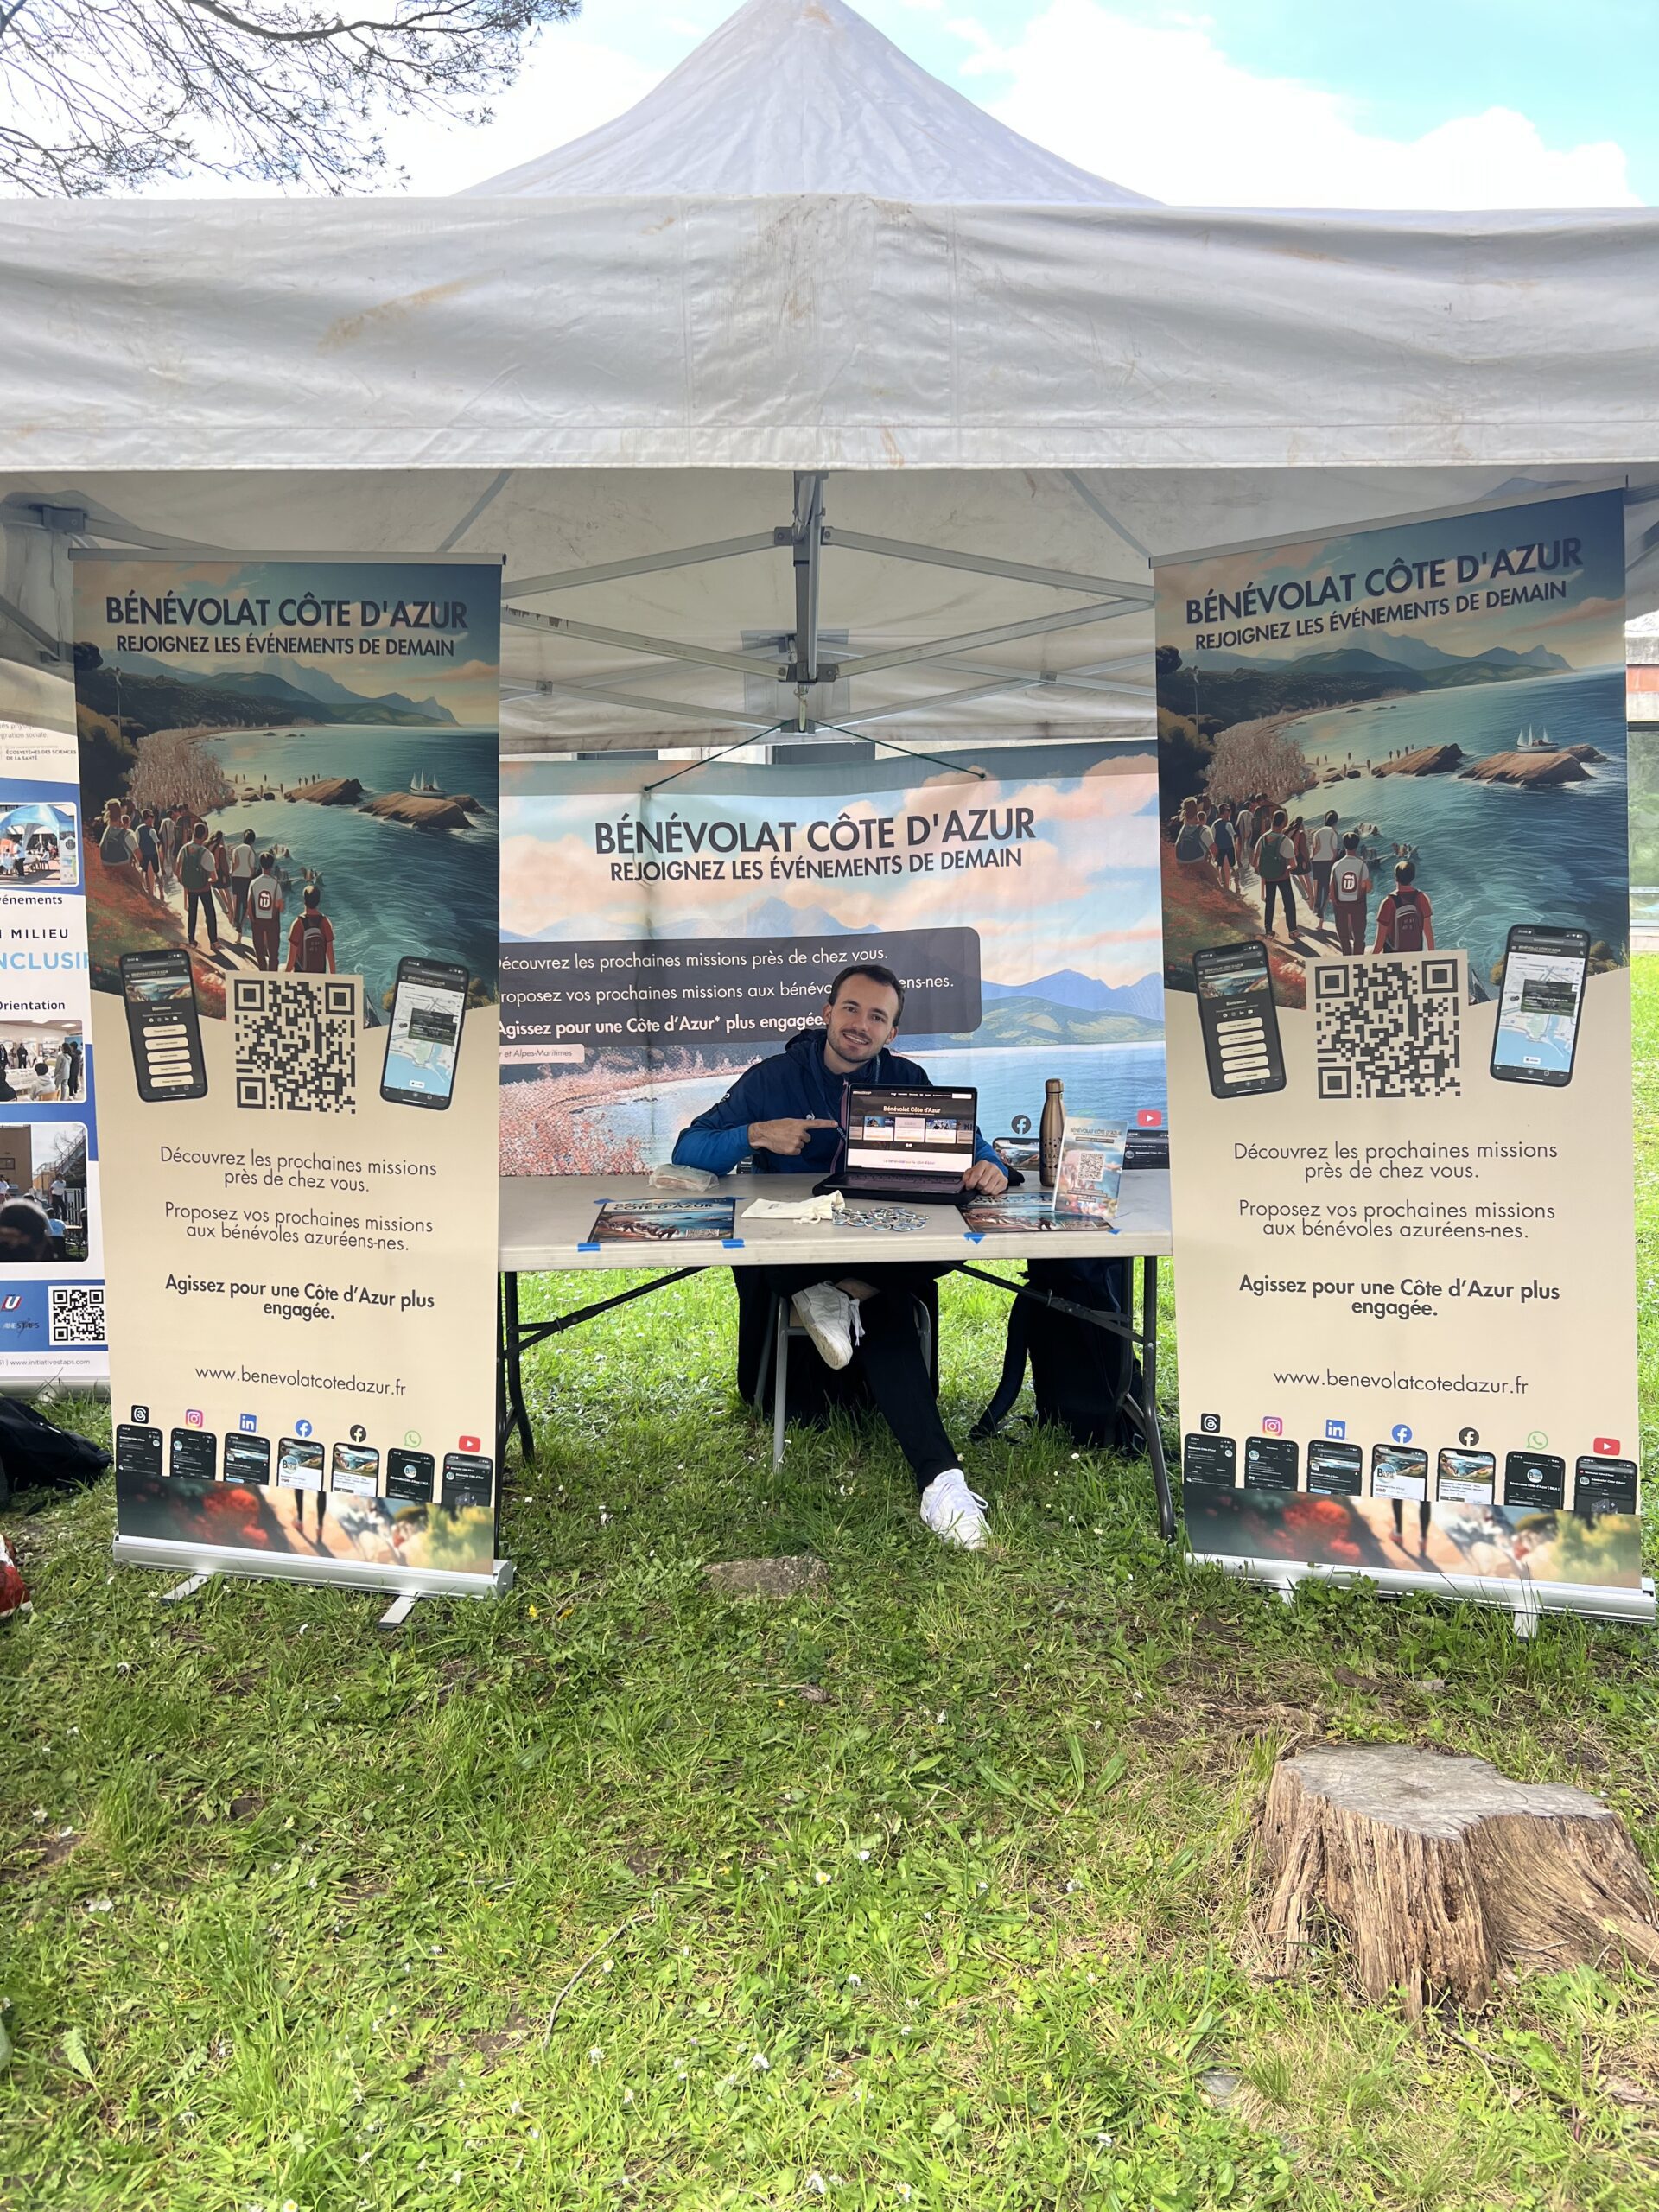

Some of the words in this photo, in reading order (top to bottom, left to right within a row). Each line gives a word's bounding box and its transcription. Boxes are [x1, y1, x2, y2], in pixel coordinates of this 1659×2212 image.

[1186, 573, 1356, 624] BÉNÉVOLAT
[1365, 556, 1446, 596] CÔTE
[1457, 537, 1583, 584] D'AZUR
[105, 589, 270, 626] BÉNÉVOLAT
[278, 591, 351, 627] CÔTE
[360, 600, 468, 629] D'AZUR
[1195, 621, 1291, 650] REJOIGNEZ
[1296, 617, 1324, 636] LES
[1330, 598, 1450, 632] ÉVÉNEMENTS
[1456, 593, 1479, 613] DE
[1486, 580, 1567, 609] DEMAIN
[117, 635, 210, 652] REJOIGNEZ
[214, 636, 241, 654] LES
[246, 632, 354, 654] ÉVÉNEMENTS
[359, 638, 380, 655] DE
[386, 639, 454, 657] DEMAIN
[595, 812, 796, 854] BÉNÉVOLAT
[807, 812, 895, 852] CÔTE
[906, 807, 1036, 846] D'AZUR
[610, 861, 725, 881] REJOIGNEZ
[732, 861, 763, 880] LES
[770, 855, 902, 880] ÉVÉNEMENTS
[909, 852, 934, 873] DE
[941, 848, 1022, 870] DEMAIN
[0, 894, 63, 905] énements
[11, 929, 68, 938] MILIEU
[499, 956, 570, 970] écouvrez
[575, 952, 594, 969] les
[600, 951, 681, 972] prochaines
[686, 952, 747, 967] missions
[752, 950, 784, 969] près
[788, 948, 807, 964] de
[812, 947, 848, 963] chez
[852, 949, 888, 961] vous.
[0, 1001, 66, 1010] rientation
[501, 991, 562, 1007] roposez
[566, 991, 591, 1001] vos
[596, 984, 677, 1005] prochaines
[683, 985, 743, 999] missions
[747, 987, 776, 997] aux
[780, 981, 832, 996] bénévo
[556, 1022, 591, 1039] pour
[595, 1021, 622, 1033] une
[626, 1017, 660, 1033] Côte
[726, 1014, 755, 1033] plus
[760, 1012, 828, 1031] engagée.
[513, 1048, 573, 1059] Alpes-Maritimes
[160, 1146, 245, 1166] Découvrez
[251, 1148, 271, 1166] les
[277, 1152, 362, 1173] prochaines
[368, 1159, 437, 1176] missions
[1234, 1142, 1328, 1159] Découvrez
[1335, 1141, 1358, 1159] les
[1366, 1140, 1470, 1164] prochaines
[1477, 1141, 1558, 1158] missions
[224, 1168, 257, 1188] près
[263, 1168, 283, 1185] de
[289, 1170, 325, 1189] chez
[330, 1179, 369, 1192] vous.
[1305, 1161, 1343, 1183] près
[1349, 1160, 1372, 1179] de
[1379, 1160, 1424, 1178] chez
[1430, 1166, 1479, 1179] vous.
[165, 1201, 238, 1224] Proposez
[243, 1210, 270, 1223] vos
[275, 1208, 359, 1228] prochaines
[365, 1215, 433, 1232] missions
[1239, 1199, 1320, 1221] Proposez
[1326, 1205, 1357, 1217] vos
[1364, 1198, 1468, 1222] prochaines
[1475, 1201, 1555, 1218] missions
[186, 1226, 216, 1237] aux
[221, 1221, 299, 1243] bénévoles
[304, 1230, 409, 1251] azuréens-nes.
[1263, 1224, 1296, 1236] aux
[1302, 1217, 1393, 1236] bénévoles
[1399, 1221, 1529, 1238] azuréens-nes.
[165, 1274, 225, 1295] Agissez
[230, 1281, 266, 1298] pour
[271, 1285, 299, 1298] une
[304, 1282, 339, 1300] Côte
[343, 1284, 395, 1306] d'Azur
[401, 1289, 435, 1312] plus
[1239, 1274, 1306, 1296] Agissez
[1313, 1281, 1355, 1299] pour
[1361, 1282, 1395, 1295] une
[1400, 1279, 1442, 1296] Côte
[1448, 1278, 1514, 1297] d'Azur
[1521, 1279, 1560, 1303] plus
[263, 1302, 334, 1322] engagée.
[1351, 1299, 1438, 1320] engagée.
[195, 1364, 406, 1396] www.benevolatcotedazur.fr
[1273, 1368, 1529, 1395] www.benevolatcotedazur.fr
